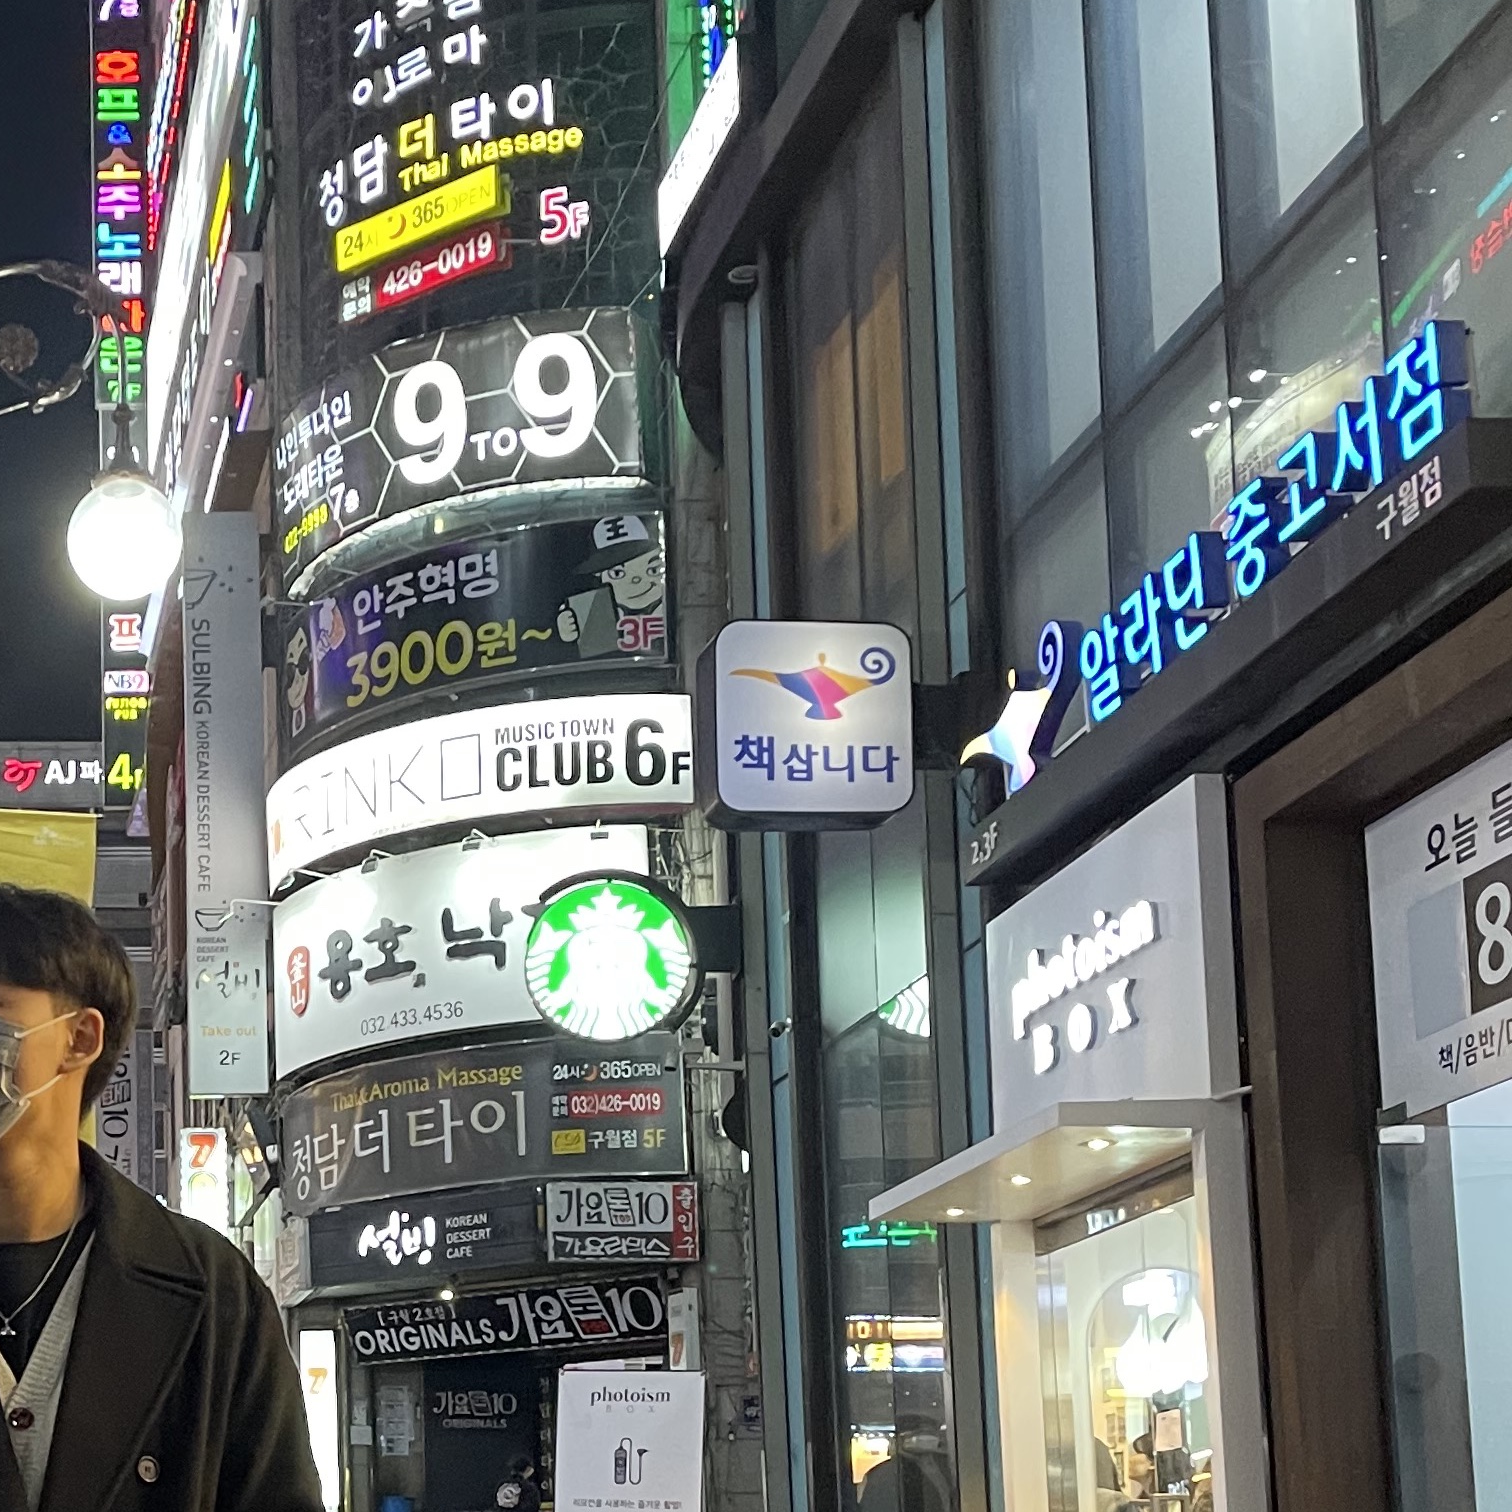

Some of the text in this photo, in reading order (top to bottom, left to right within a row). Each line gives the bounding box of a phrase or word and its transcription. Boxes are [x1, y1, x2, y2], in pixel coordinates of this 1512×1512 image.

[397, 126, 584, 193] Thai Massage
[540, 186, 589, 245] 5F
[382, 231, 493, 296] 426-0019
[394, 332, 598, 485] 9 TO 9
[1376, 455, 1442, 541] 구월점
[1079, 321, 1445, 722] 알라딘 중고서점
[353, 549, 500, 636] 안주혁명
[616, 616, 665, 652] 3F
[494, 717, 616, 746] MUSIC TOWN
[43, 758, 105, 786] AJ파
[191, 618, 212, 893] SULBING KOREAN DESSERT CAFE
[495, 739, 615, 794] CLUB
[625, 717, 691, 787] 6F
[782, 743, 900, 784] 삽니다
[1425, 812, 1479, 873] 오늘
[196, 936, 227, 944] KOREAN
[196, 955, 216, 963] CAFE
[1011, 899, 1154, 1041] photoism
[200, 1024, 258, 1037] Take out
[360, 1000, 465, 1037] 032.433.4536
[1032, 977, 1133, 1076] BOX
[219, 1049, 241, 1066] 2F
[437, 1064, 524, 1091] Massage
[571, 1092, 662, 1115] 032)426-0019
[587, 1129, 638, 1150] 구월점
[642, 1128, 667, 1149] 5F
[358, 1210, 437, 1267] 설빙
[444, 1212, 489, 1229] KOREAN
[444, 1228, 493, 1245] DESSERT
[675, 1186, 696, 1257] 출입구
[445, 1245, 474, 1260] CAFE
[354, 1317, 497, 1357] ORIGINALS
[590, 1386, 671, 1407] photoism
